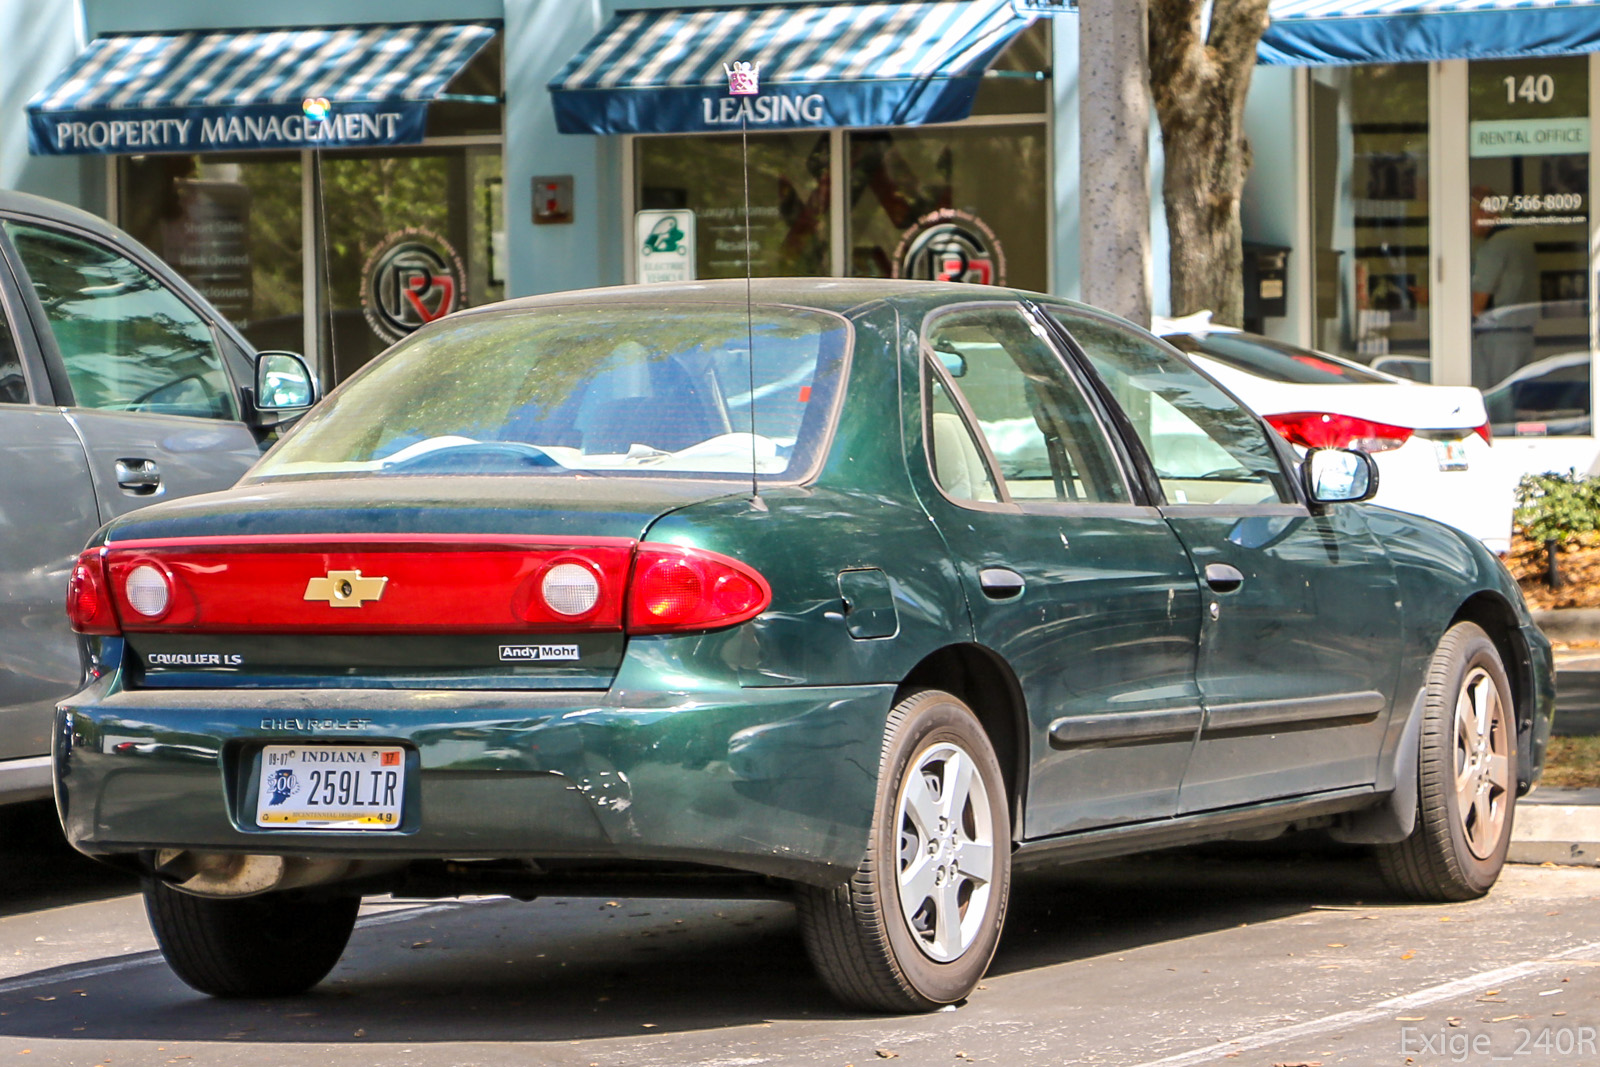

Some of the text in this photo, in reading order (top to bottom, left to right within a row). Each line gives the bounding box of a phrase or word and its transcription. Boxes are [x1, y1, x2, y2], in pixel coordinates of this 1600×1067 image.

[1503, 74, 1554, 103] 140
[702, 94, 824, 123] LEASING
[56, 113, 402, 148] PROPERTY MANAGEMENT
[1478, 128, 1583, 145] RENTAL OFFICE
[1480, 193, 1582, 212] 407-566-8009
[148, 653, 242, 665] CAVALIER LS
[503, 647, 576, 659] Andy Mohr
[260, 718, 372, 730] CHEVROLET
[301, 752, 366, 763] INDIANA
[307, 770, 397, 806] 259LIR
[377, 813, 392, 823] 49
